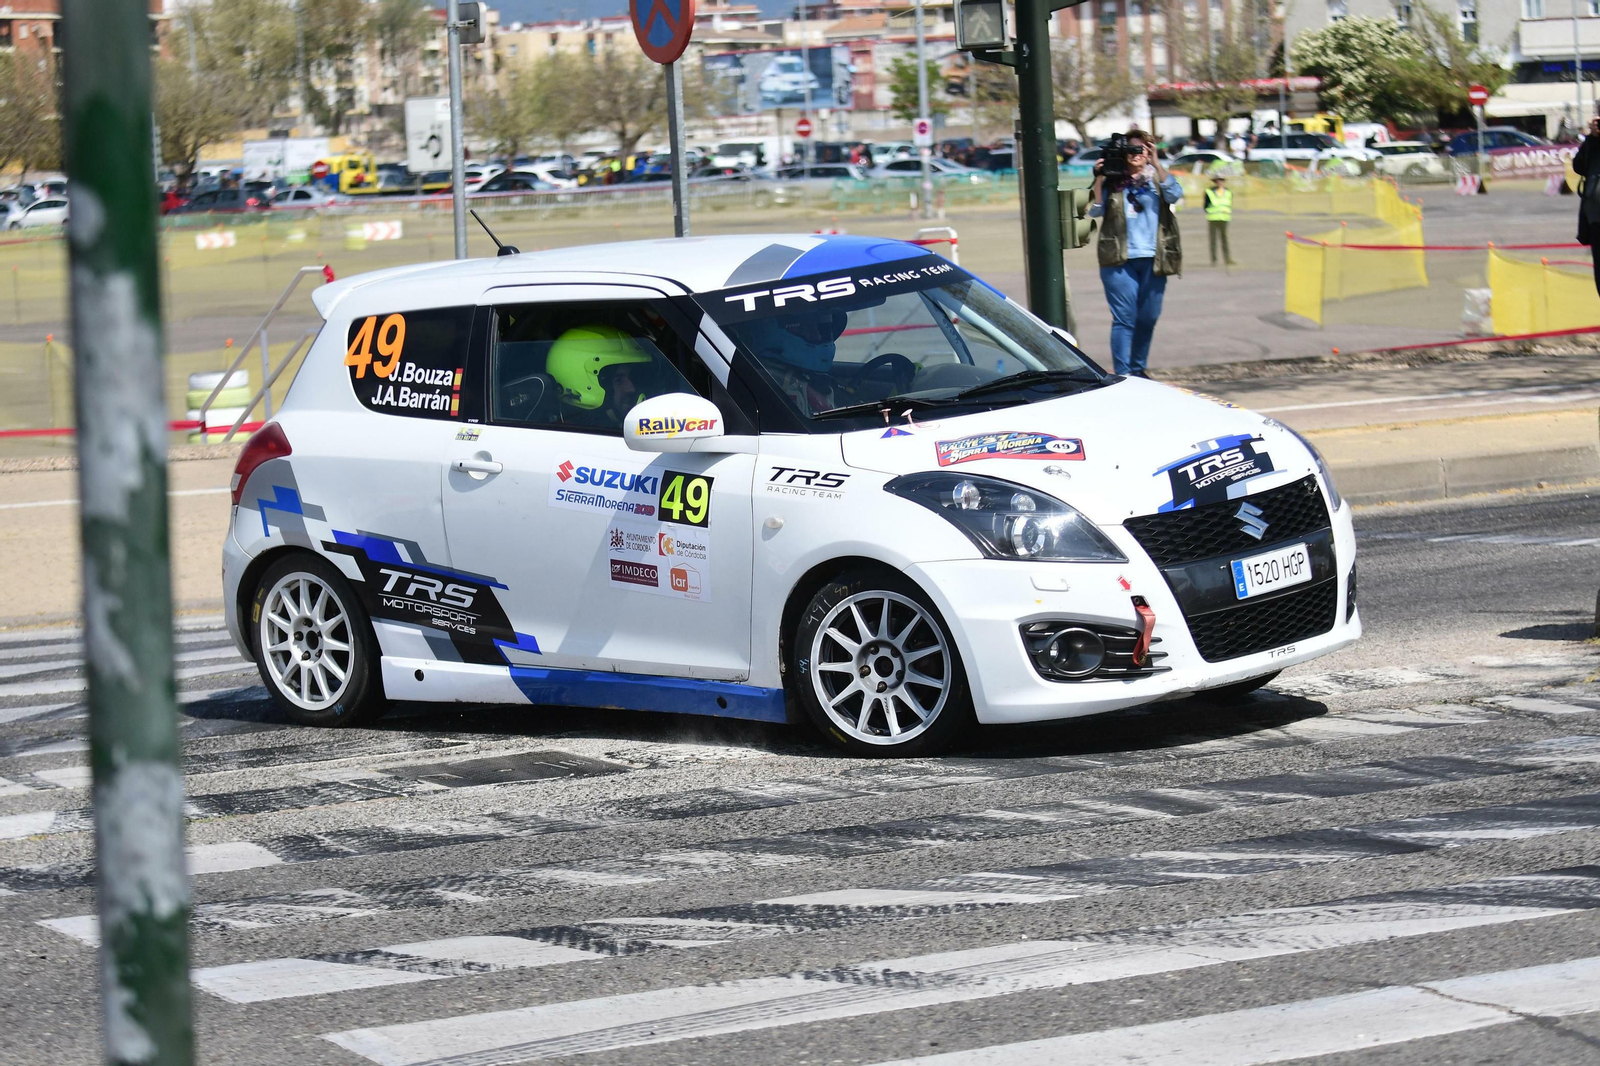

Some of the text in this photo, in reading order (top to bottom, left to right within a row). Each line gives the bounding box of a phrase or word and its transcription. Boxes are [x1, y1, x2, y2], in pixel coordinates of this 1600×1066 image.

[725, 263, 954, 312] TRS RACING TEAM
[344, 313, 406, 379] 49
[388, 361, 454, 387] J.Bouza
[371, 384, 451, 411] J.A.Barrán
[638, 417, 718, 433] Rallycar
[940, 438, 979, 455] RALLYE
[950, 446, 989, 463] SIERRA
[996, 437, 1043, 451] MORENA
[1177, 447, 1245, 481] TRS
[1194, 461, 1255, 490] MOTORSPORT
[574, 466, 659, 496] SUZUKI
[769, 466, 852, 489] TRS
[660, 474, 709, 524] 49
[766, 485, 842, 500] RACING TEAM
[621, 564, 658, 579] IMDECO
[1247, 551, 1305, 588] 1520 HGP
[379, 568, 478, 609] TRS
[1238, 582, 1246, 592] E
[383, 598, 477, 625] MOTORSPORT
[431, 617, 477, 635] SERVICES
[1268, 645, 1296, 658] TRS
